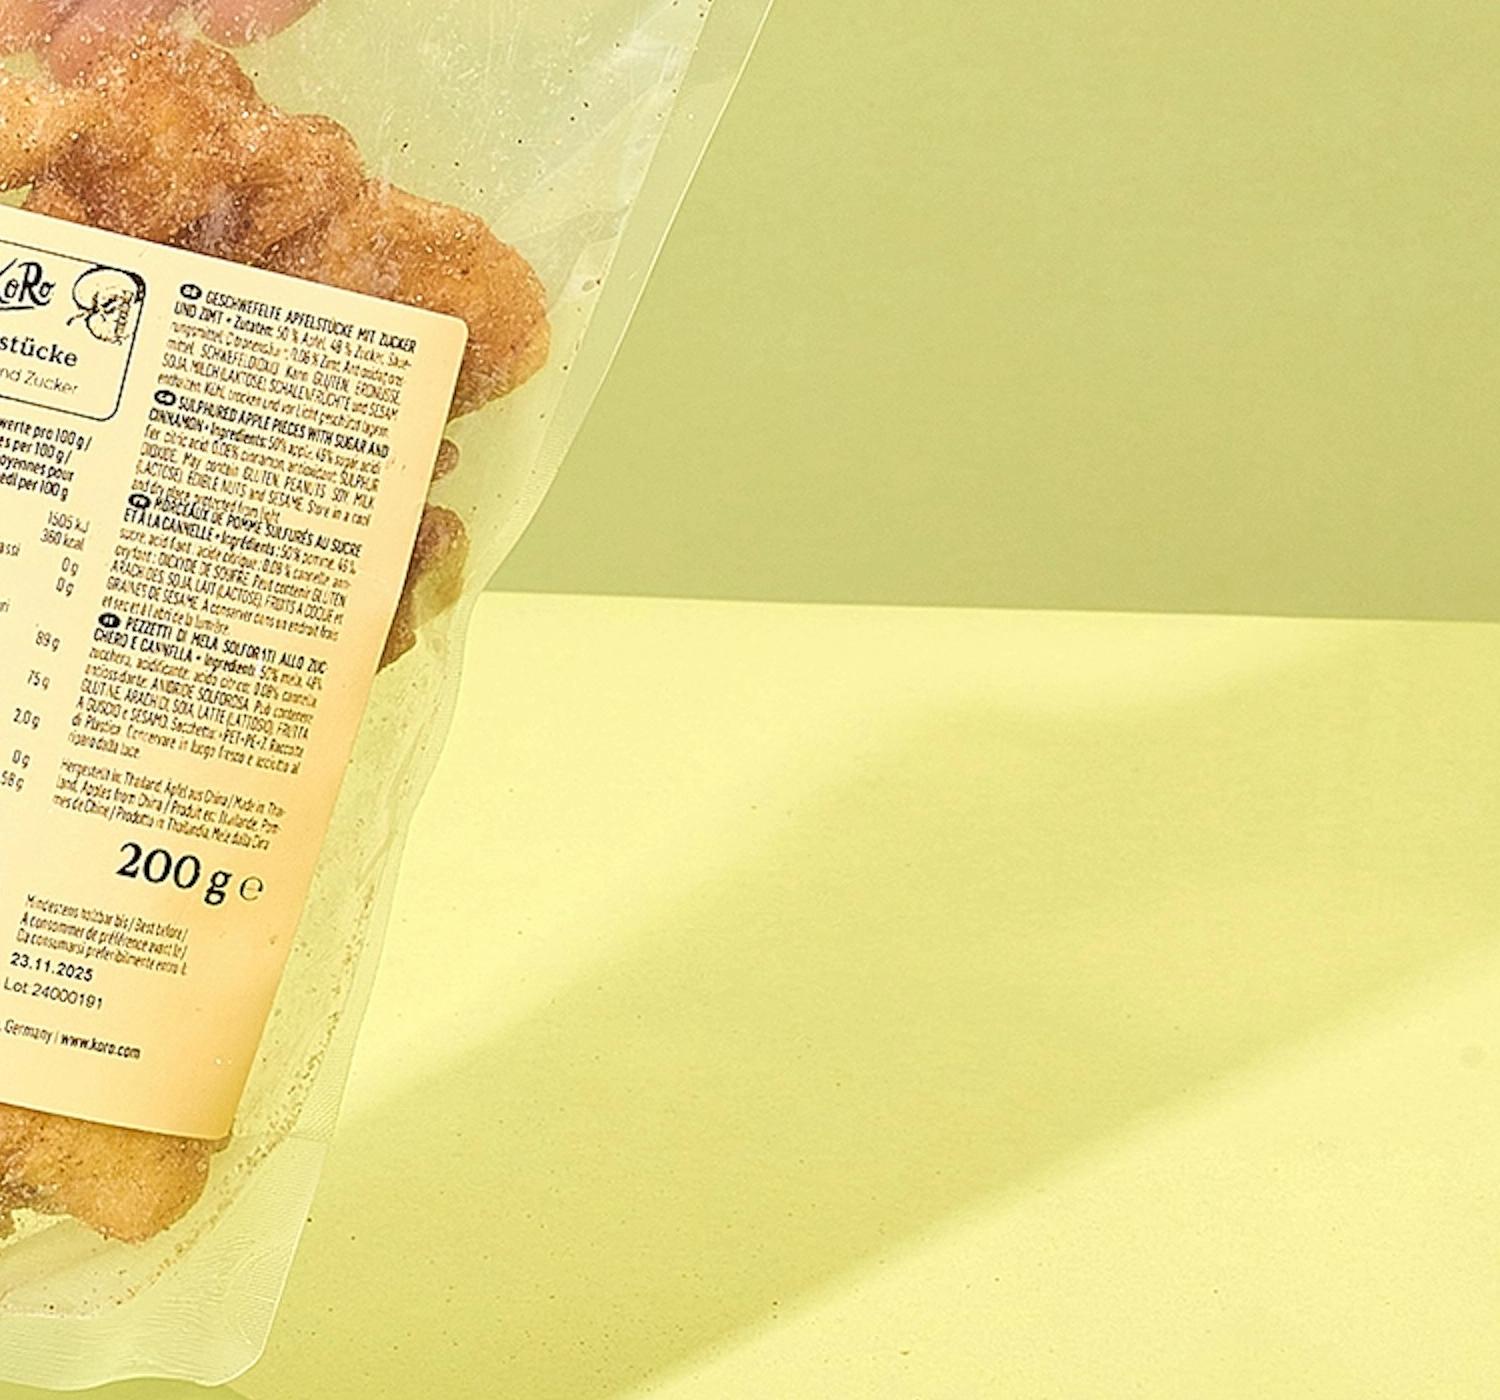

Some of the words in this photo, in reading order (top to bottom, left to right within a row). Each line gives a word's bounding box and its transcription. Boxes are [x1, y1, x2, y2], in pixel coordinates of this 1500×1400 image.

[355, 327, 377, 345] MIT
[377, 331, 418, 355] ZUCKER
[23, 369, 79, 394] Zucker
[31, 425, 55, 442] pro
[54, 427, 78, 447] 100
[237, 409, 272, 431] APPLE
[271, 417, 307, 440] PIECES
[306, 426, 335, 447] WITH
[333, 432, 368, 455] SUGAR
[366, 440, 391, 460] AND
[10, 439, 34, 454] per
[33, 440, 57, 460] 100
[16, 476, 39, 492] per
[38, 478, 62, 498] 100
[45, 465, 75, 483] pour
[189, 631, 219, 652] MELA
[115, 841, 202, 890] 200
[9, 951, 94, 983] 23.11.2025
[30, 982, 103, 1010] 24000191
[60, 1033, 141, 1060] www.koro.com
